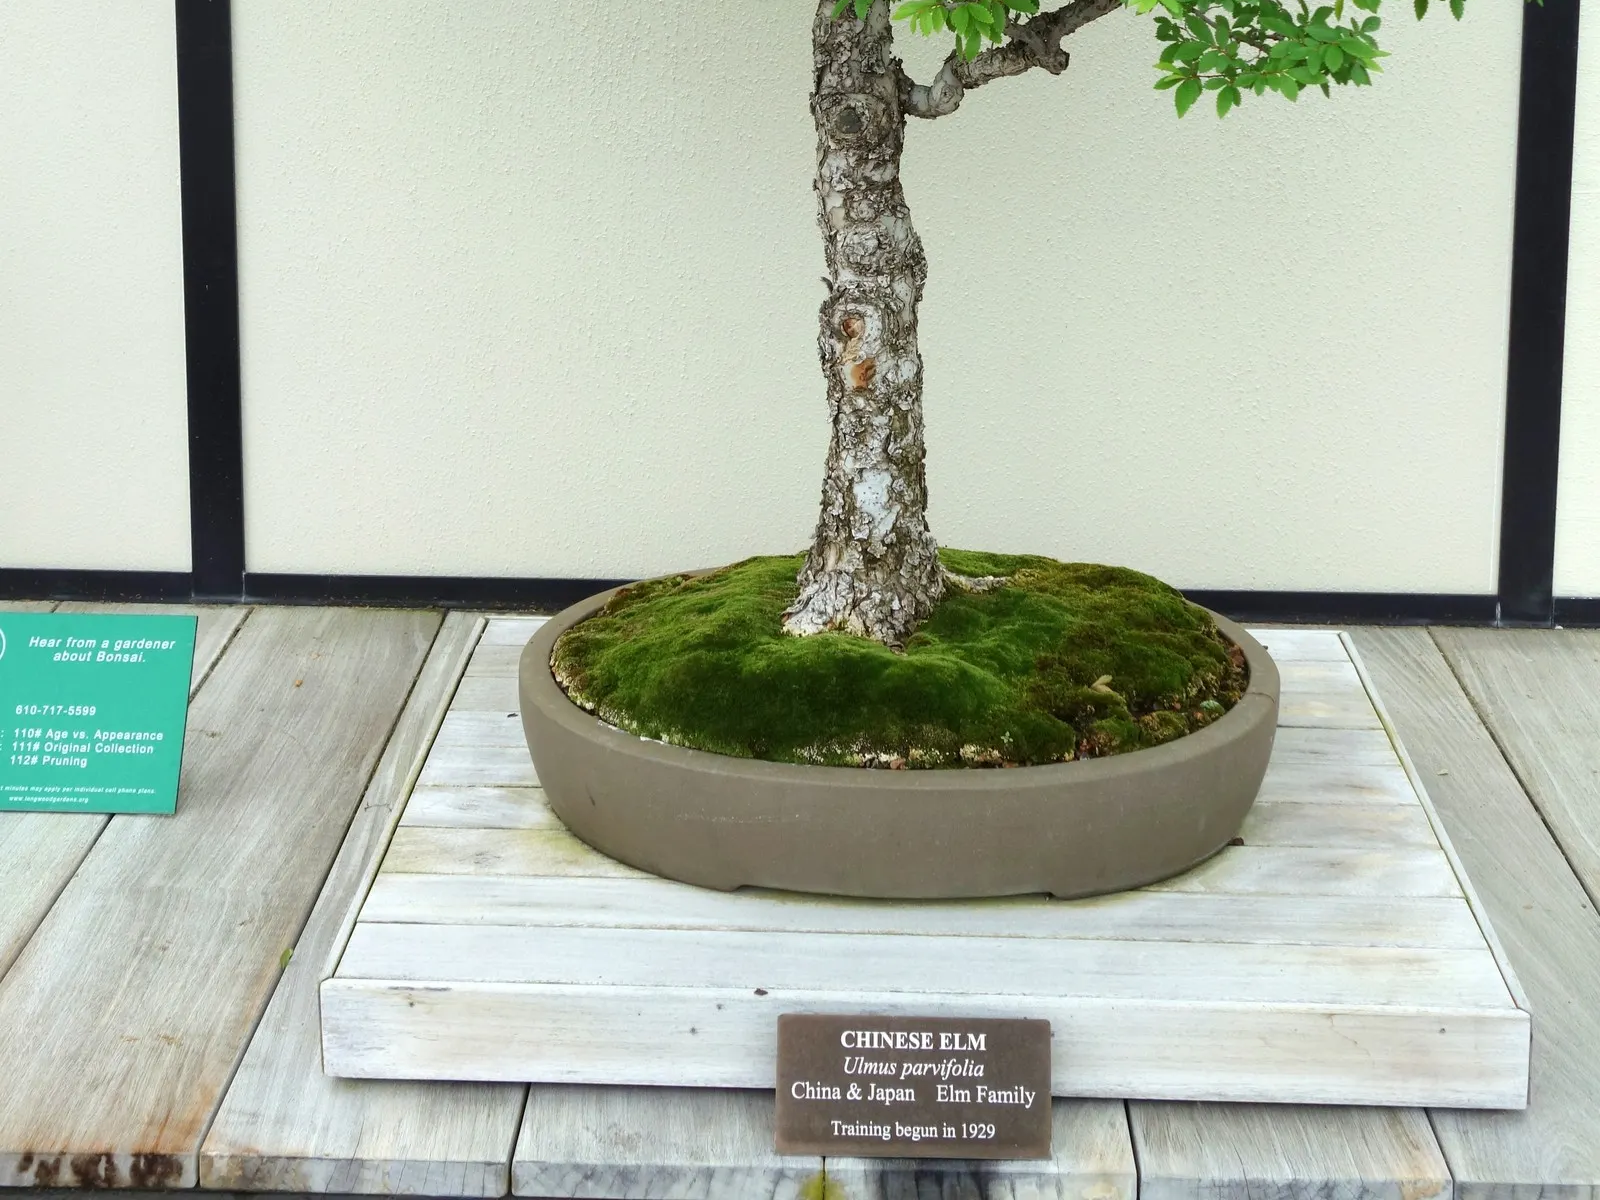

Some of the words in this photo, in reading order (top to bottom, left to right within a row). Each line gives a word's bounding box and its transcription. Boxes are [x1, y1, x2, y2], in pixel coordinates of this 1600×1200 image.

[29, 636, 62, 647] Hear
[66, 637, 96, 648] from
[101, 638, 110, 648] a
[114, 638, 176, 651] gardener
[53, 651, 91, 661] about
[96, 651, 146, 663] Bonsai.
[16, 705, 96, 715] 610-717-5599
[14, 728, 41, 738] 110#
[46, 729, 68, 741] Age
[73, 730, 89, 739] vs.
[94, 730, 163, 741] Appearance
[12, 742, 39, 751] 111#
[44, 742, 90, 754] Original
[95, 743, 153, 753] Collection
[10, 755, 37, 765] 112#
[42, 756, 88, 768] Pruning
[841, 1031, 933, 1050] CHINESE
[939, 1033, 986, 1050] ELM
[844, 1057, 896, 1075] Ulmus
[900, 1059, 984, 1080] parvifolia
[792, 1082, 841, 1100] China
[847, 1083, 862, 1100] &
[867, 1084, 915, 1105] Japan
[937, 1085, 971, 1102] Elm
[976, 1086, 1035, 1108] Family
[831, 1121, 891, 1139] Training
[895, 1122, 938, 1140] begun
[943, 1123, 956, 1138] in
[962, 1124, 995, 1138] 1929
